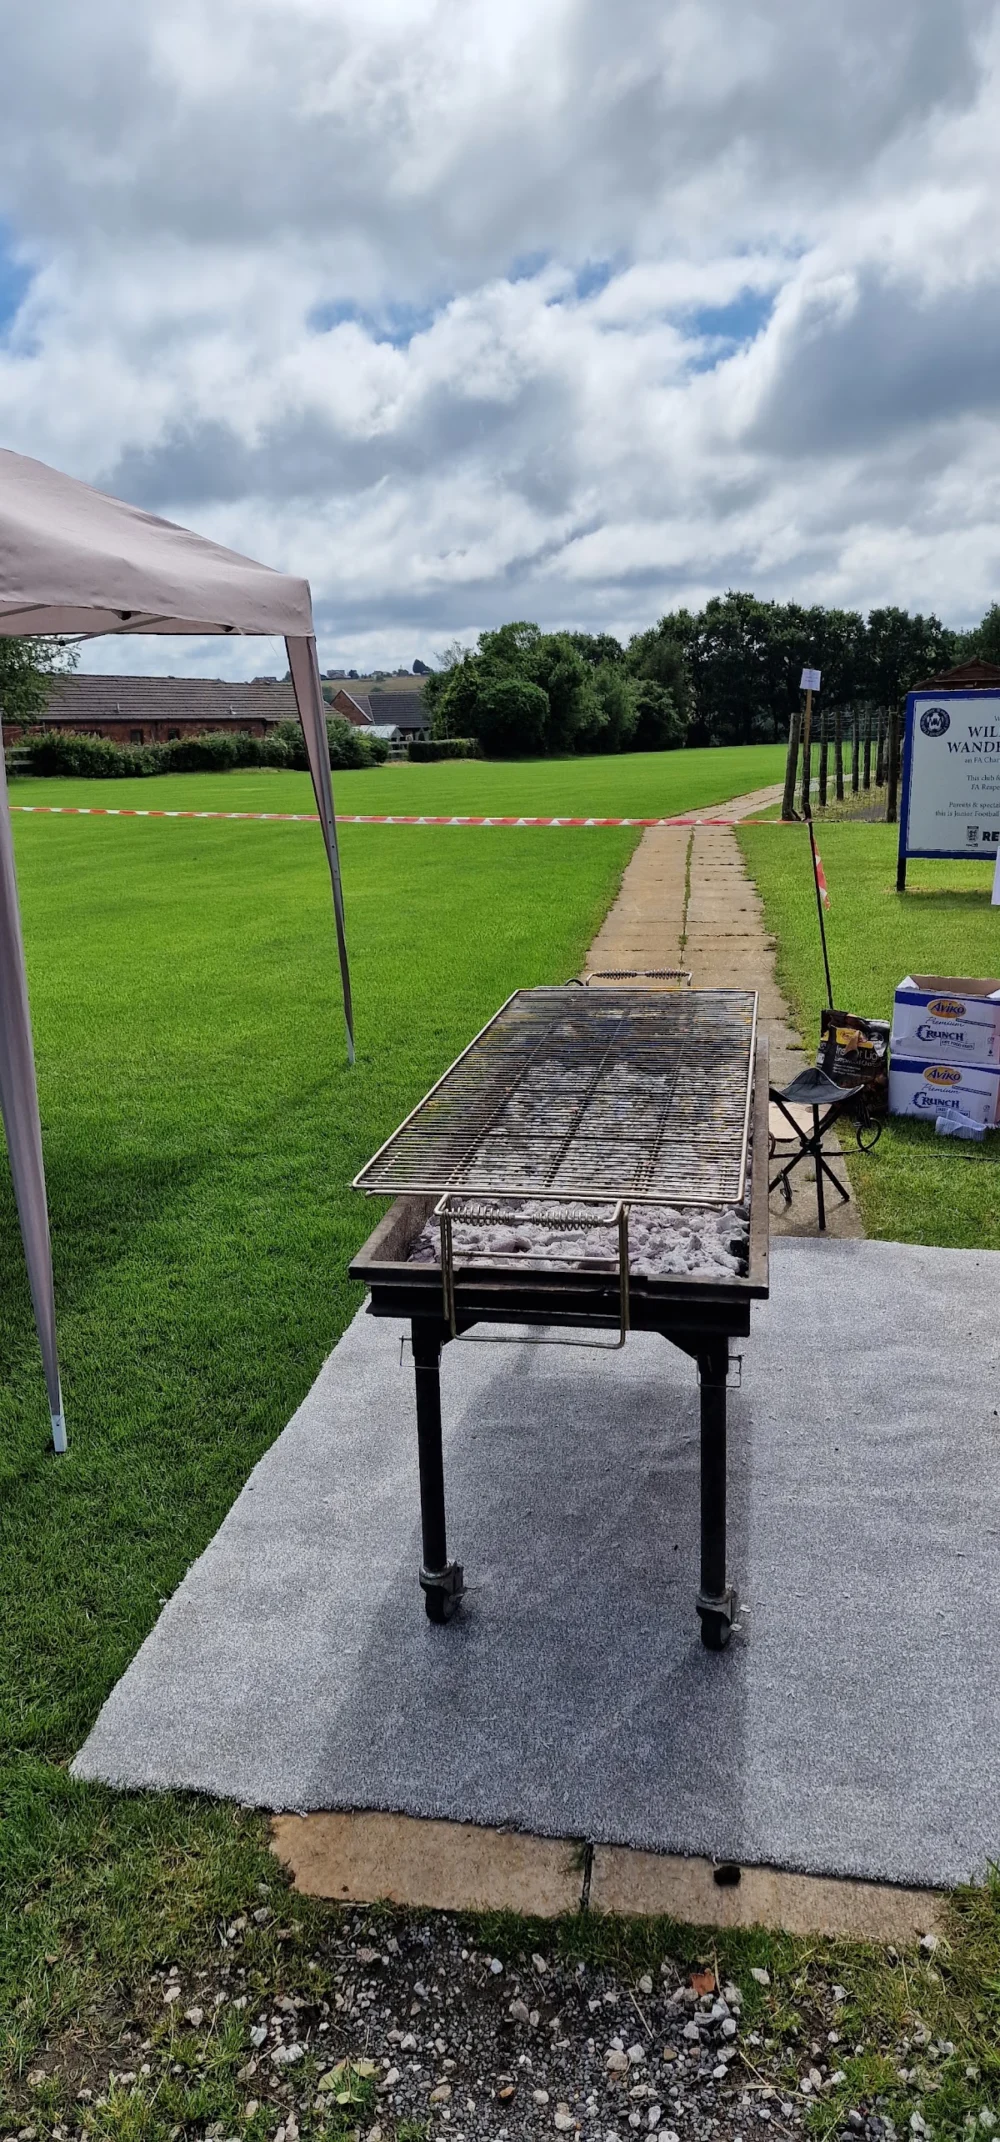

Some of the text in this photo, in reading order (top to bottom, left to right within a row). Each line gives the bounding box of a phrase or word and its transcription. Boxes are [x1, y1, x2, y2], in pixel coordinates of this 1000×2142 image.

[968, 725, 1000, 738] WIL
[930, 1001, 965, 1014] Aviko
[925, 1016, 966, 1027] Premium
[926, 1068, 962, 1081] Aviko
[921, 1082, 961, 1094] Premium
